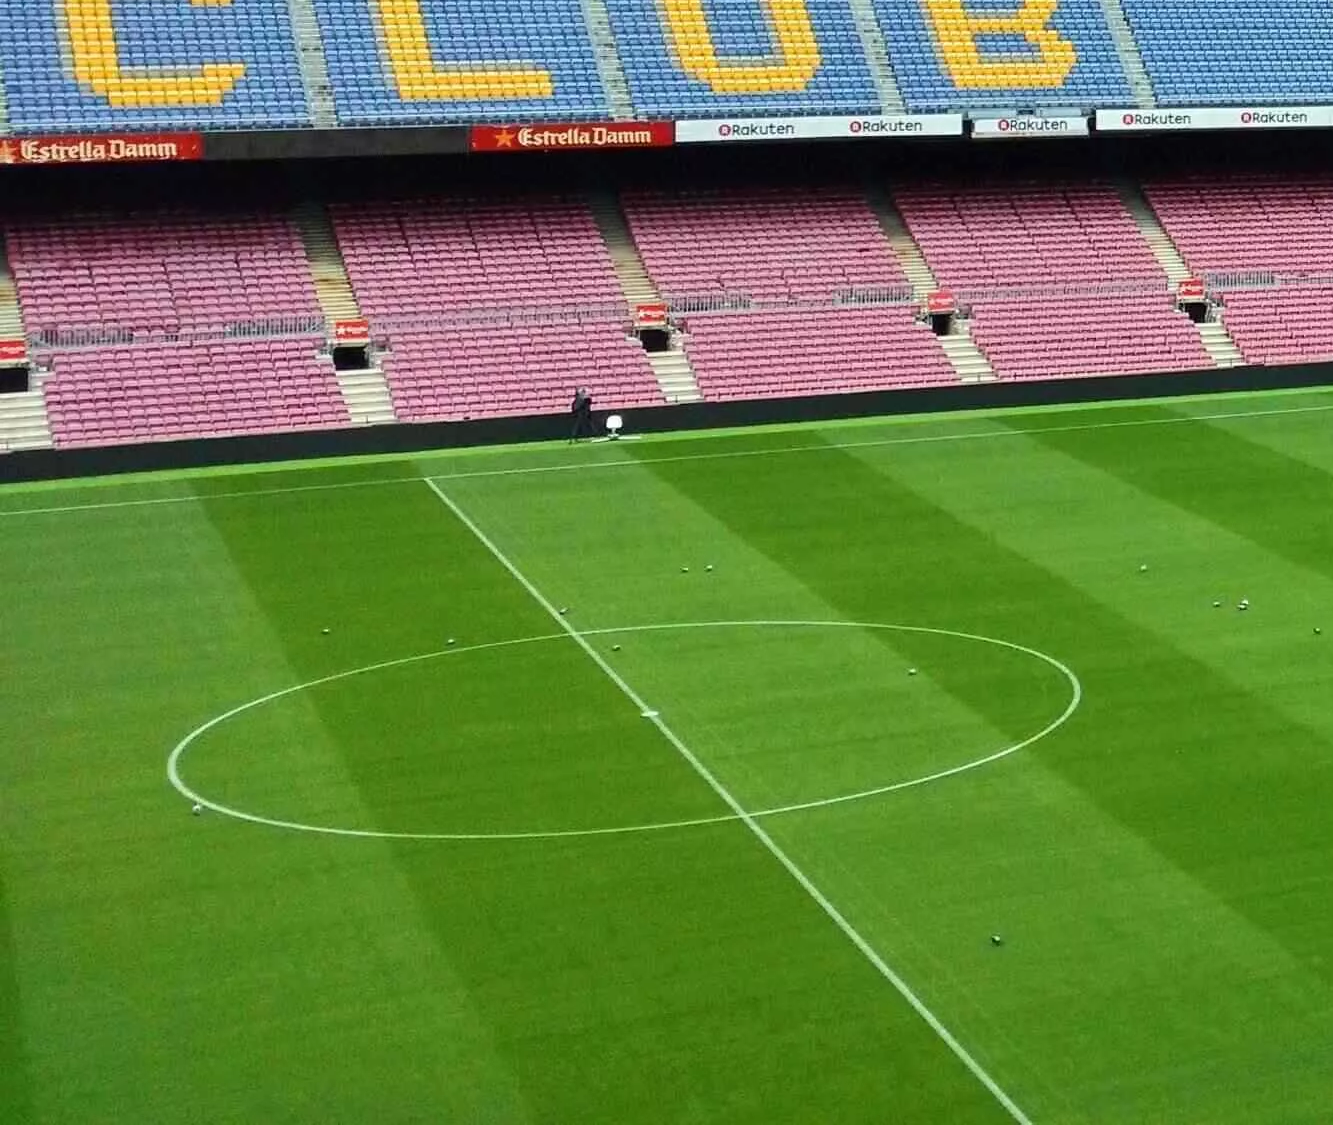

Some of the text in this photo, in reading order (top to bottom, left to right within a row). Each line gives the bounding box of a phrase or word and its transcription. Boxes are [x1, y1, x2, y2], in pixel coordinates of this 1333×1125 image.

[1134, 113, 1192, 125] Rakuten
[1251, 111, 1308, 124] Rakuten
[730, 122, 795, 137] Rakuten
[860, 120, 922, 133] Rakuten
[1010, 118, 1068, 132] Rakuten
[517, 126, 652, 147] Estrella Damm
[20, 138, 178, 161] Estrella Damm
